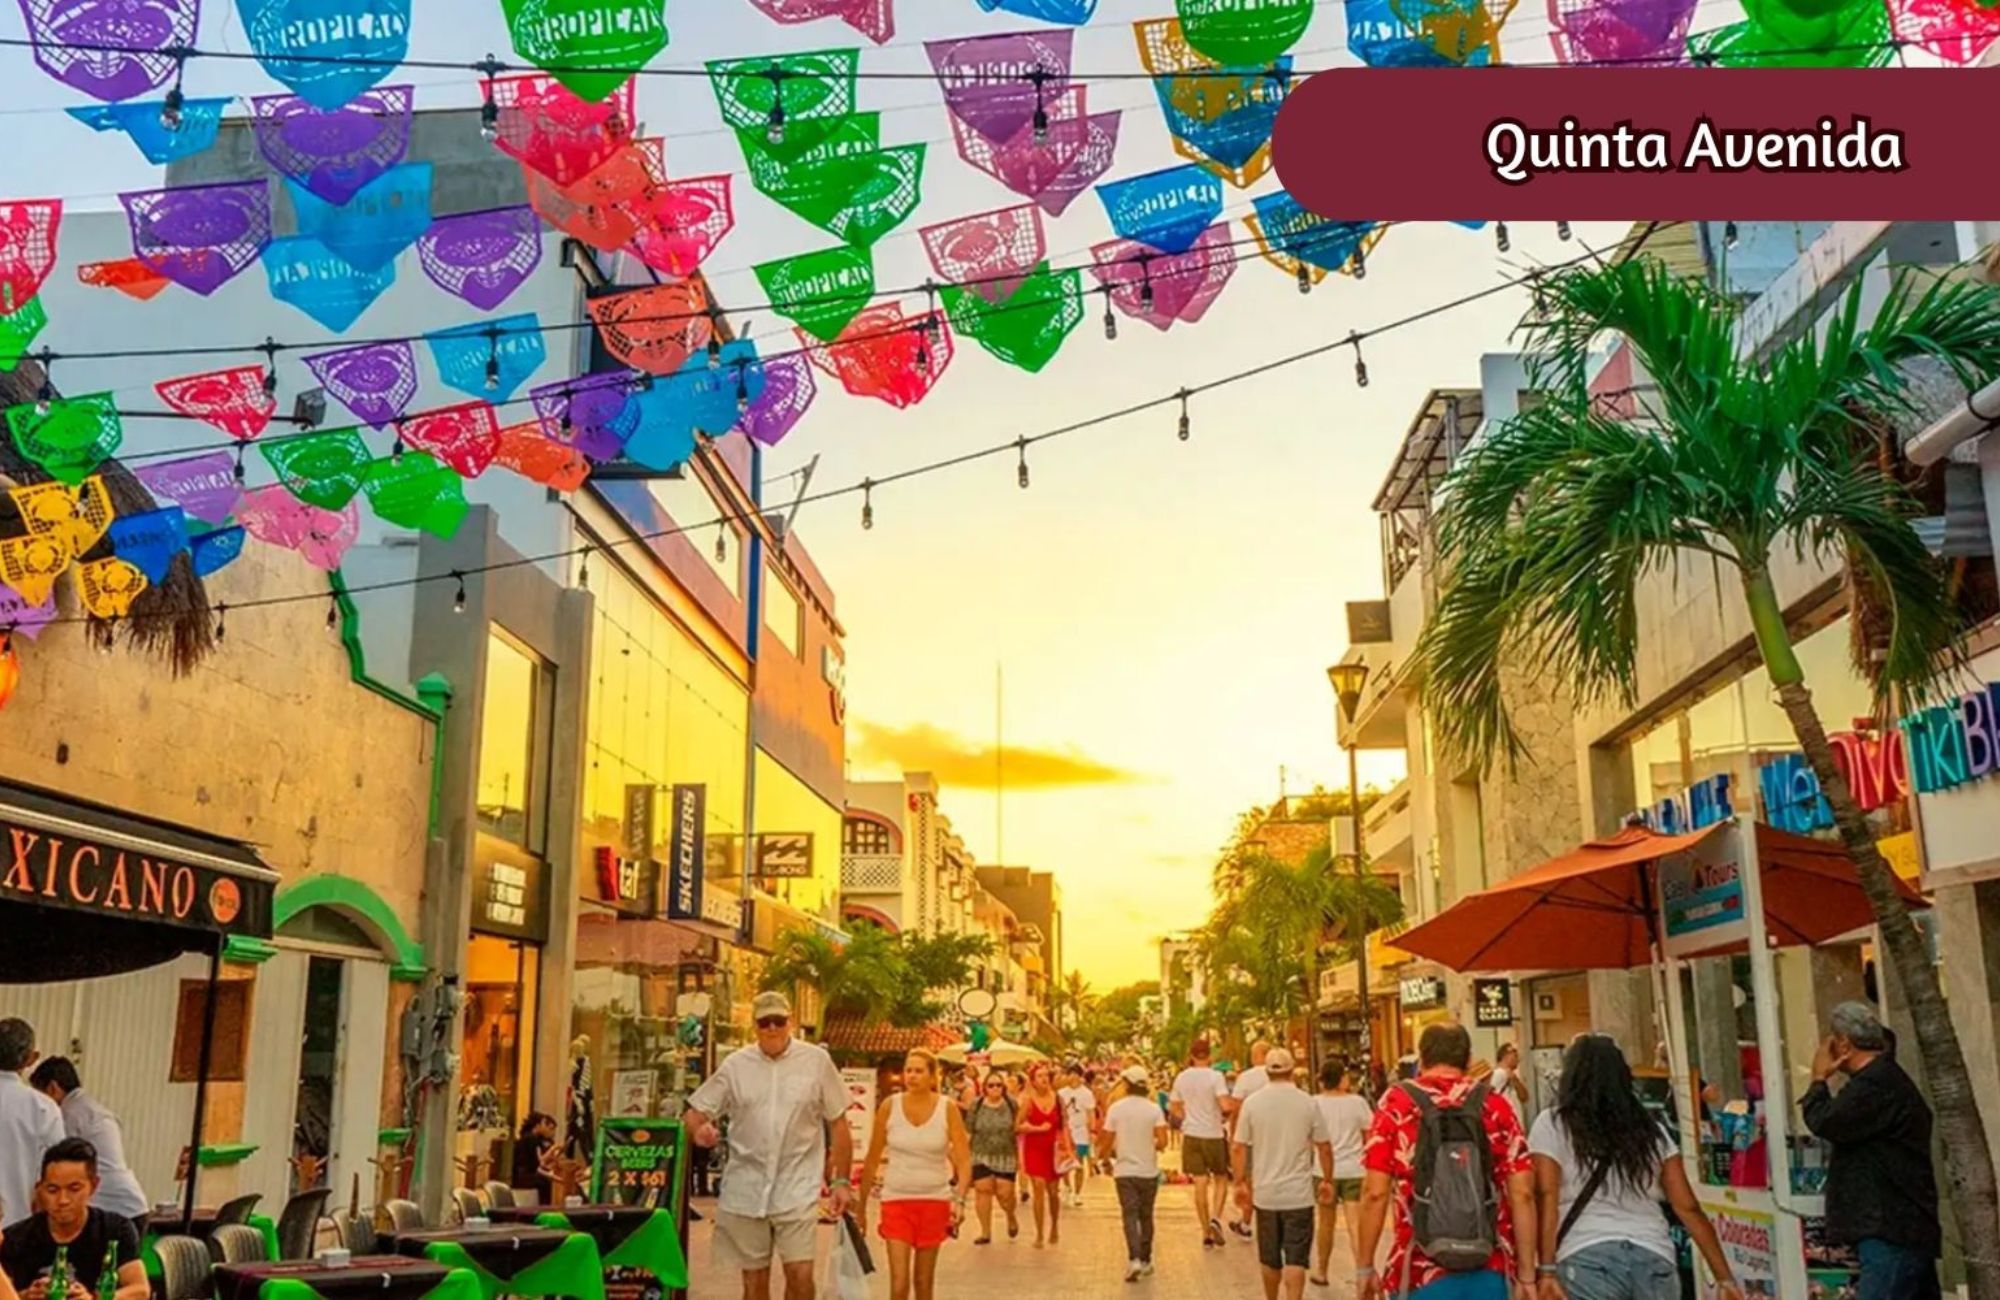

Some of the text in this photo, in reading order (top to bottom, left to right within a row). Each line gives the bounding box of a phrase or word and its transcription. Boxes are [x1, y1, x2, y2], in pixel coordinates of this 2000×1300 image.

[677, 788, 697, 915] SKECHERS
[2, 827, 196, 920] XICANO
[1478, 1013, 1509, 1021] CLARA
[606, 1146, 674, 1159] CERVEZAS
[607, 1170, 620, 1186] 2
